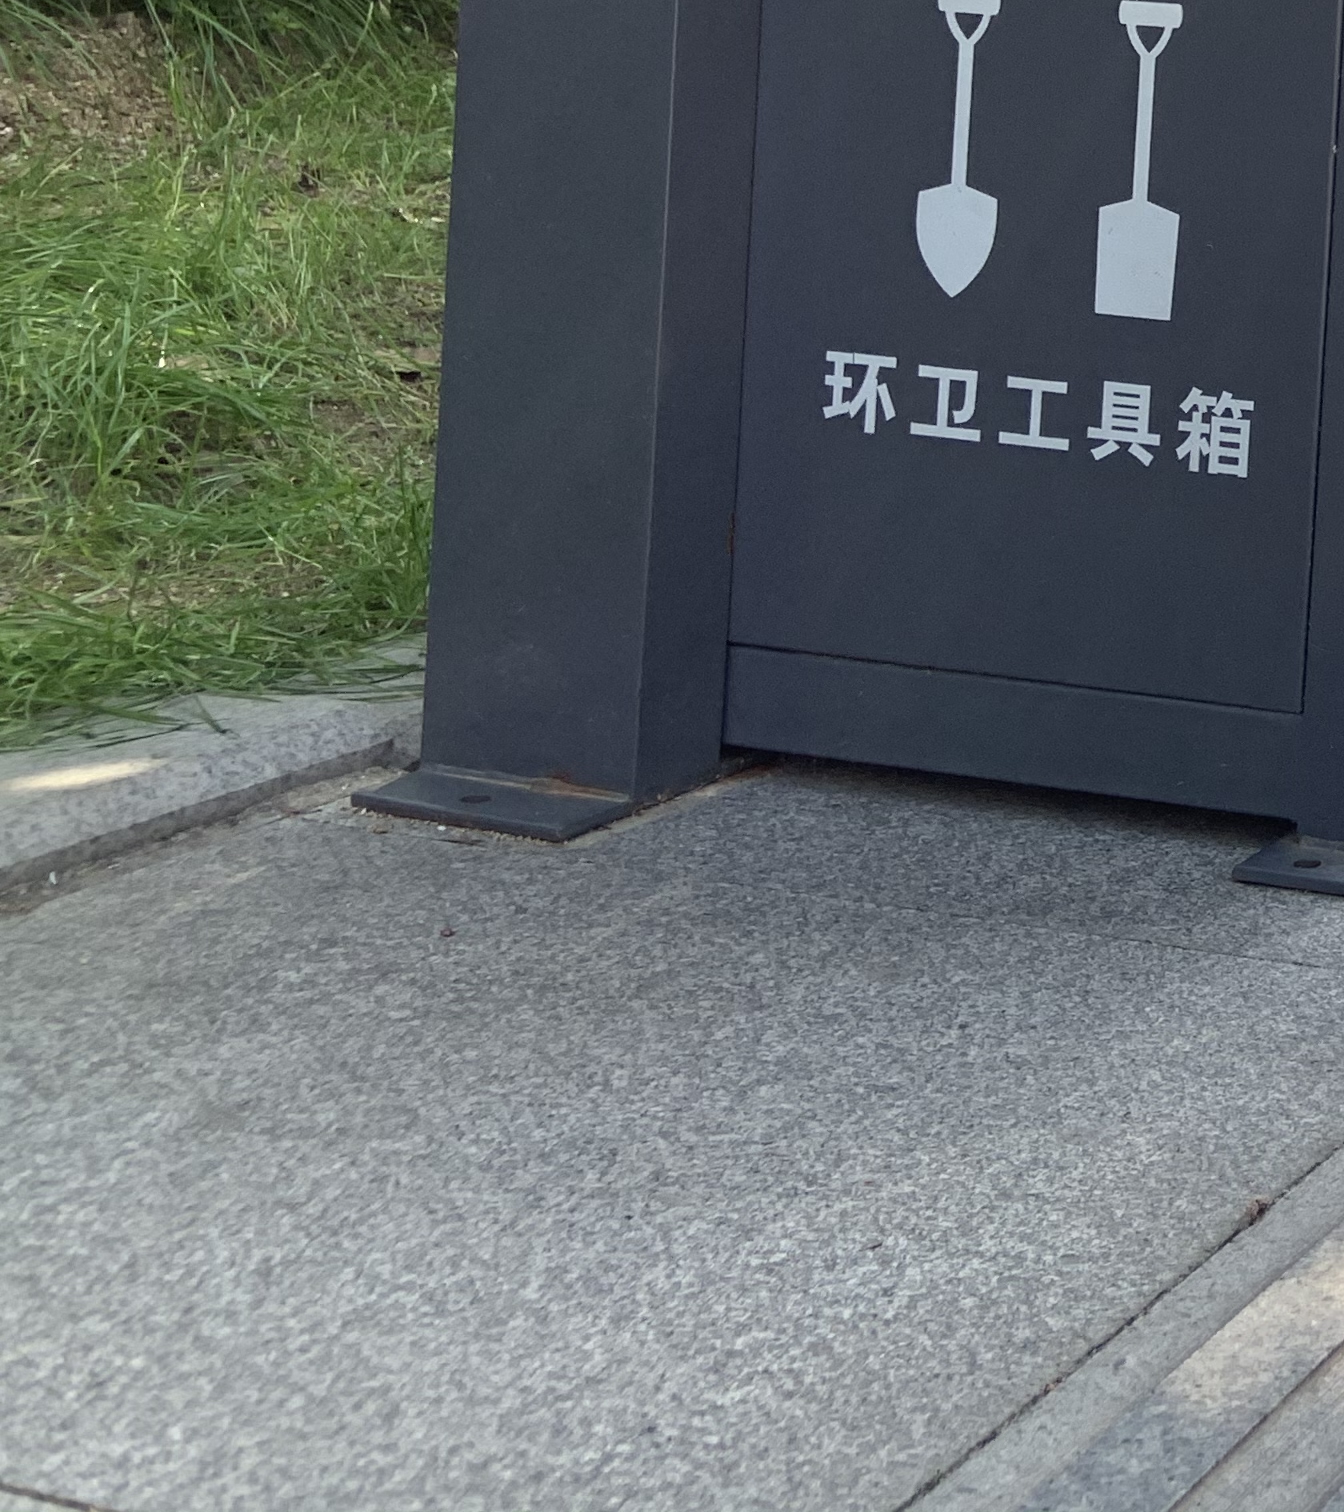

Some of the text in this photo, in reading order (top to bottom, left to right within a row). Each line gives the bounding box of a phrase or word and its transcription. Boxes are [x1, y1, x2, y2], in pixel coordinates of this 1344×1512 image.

[823, 350, 1255, 478] 环卫工具箱
